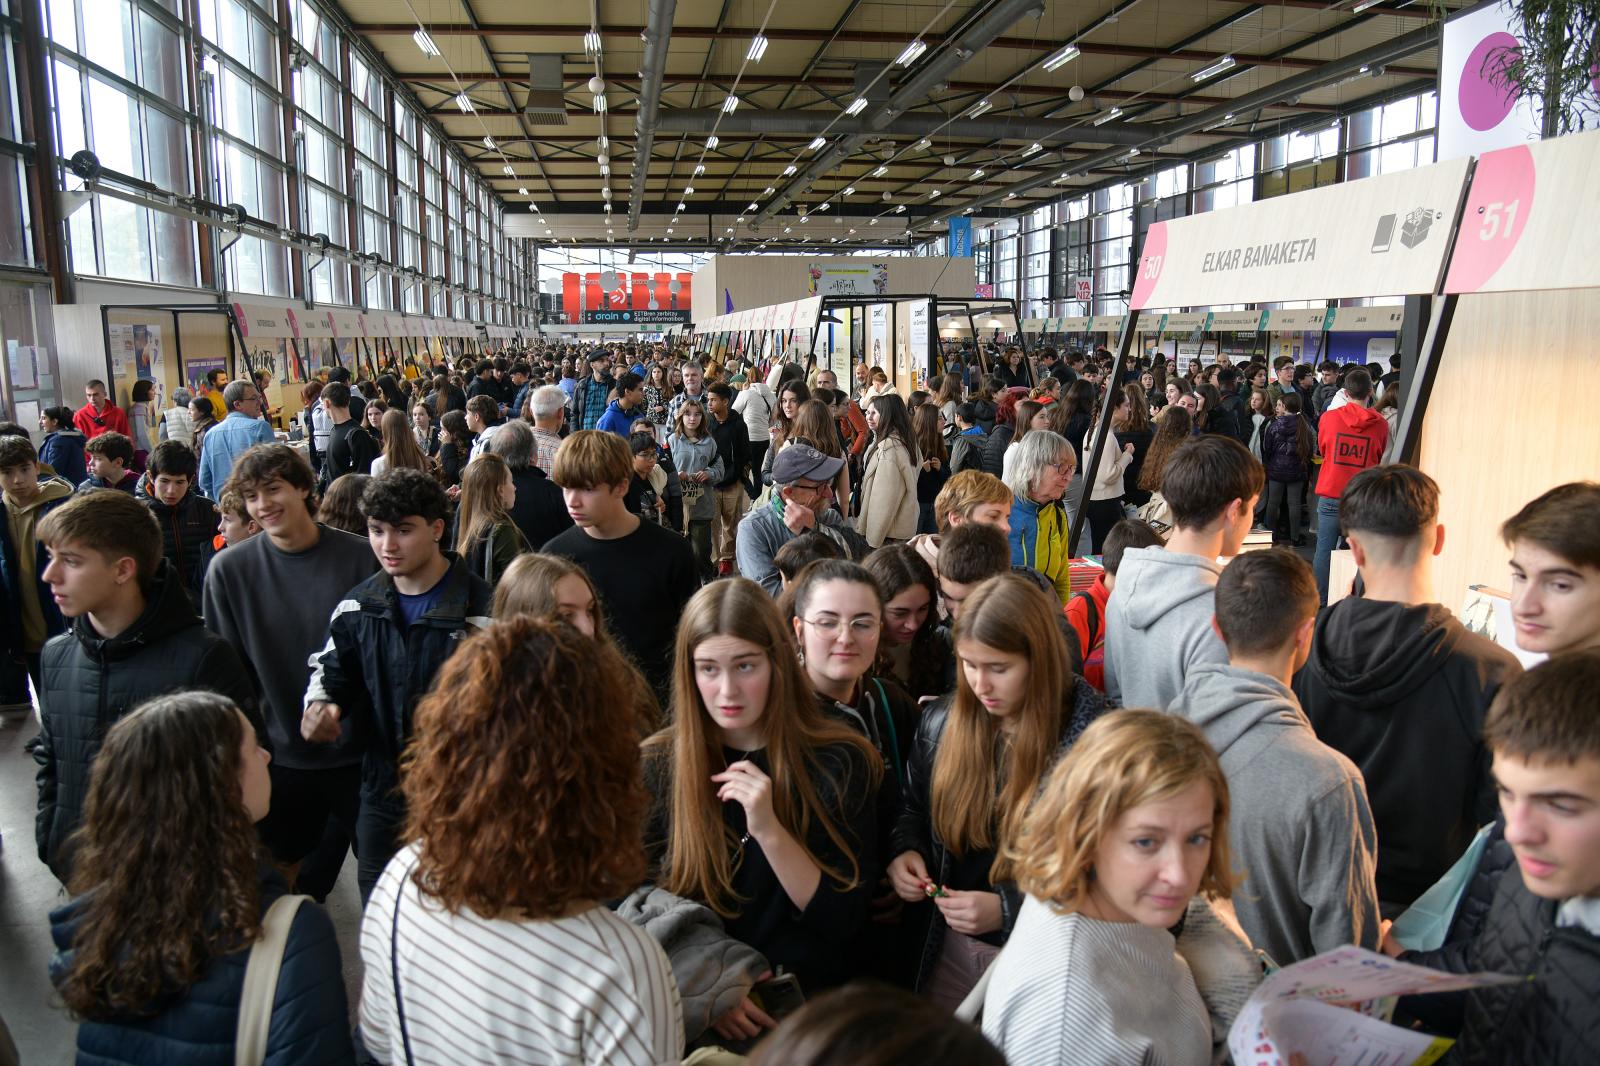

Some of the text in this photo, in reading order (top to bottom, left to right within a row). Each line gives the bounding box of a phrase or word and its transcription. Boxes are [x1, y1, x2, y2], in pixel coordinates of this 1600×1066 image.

[1479, 198, 1520, 241] 51
[1201, 237, 1317, 273] ELKAR BANAKETA
[1144, 255, 1163, 279] 50
[1076, 291, 1091, 300] NIZ
[1077, 281, 1091, 290] YA
[1339, 442, 1365, 459] DA!
